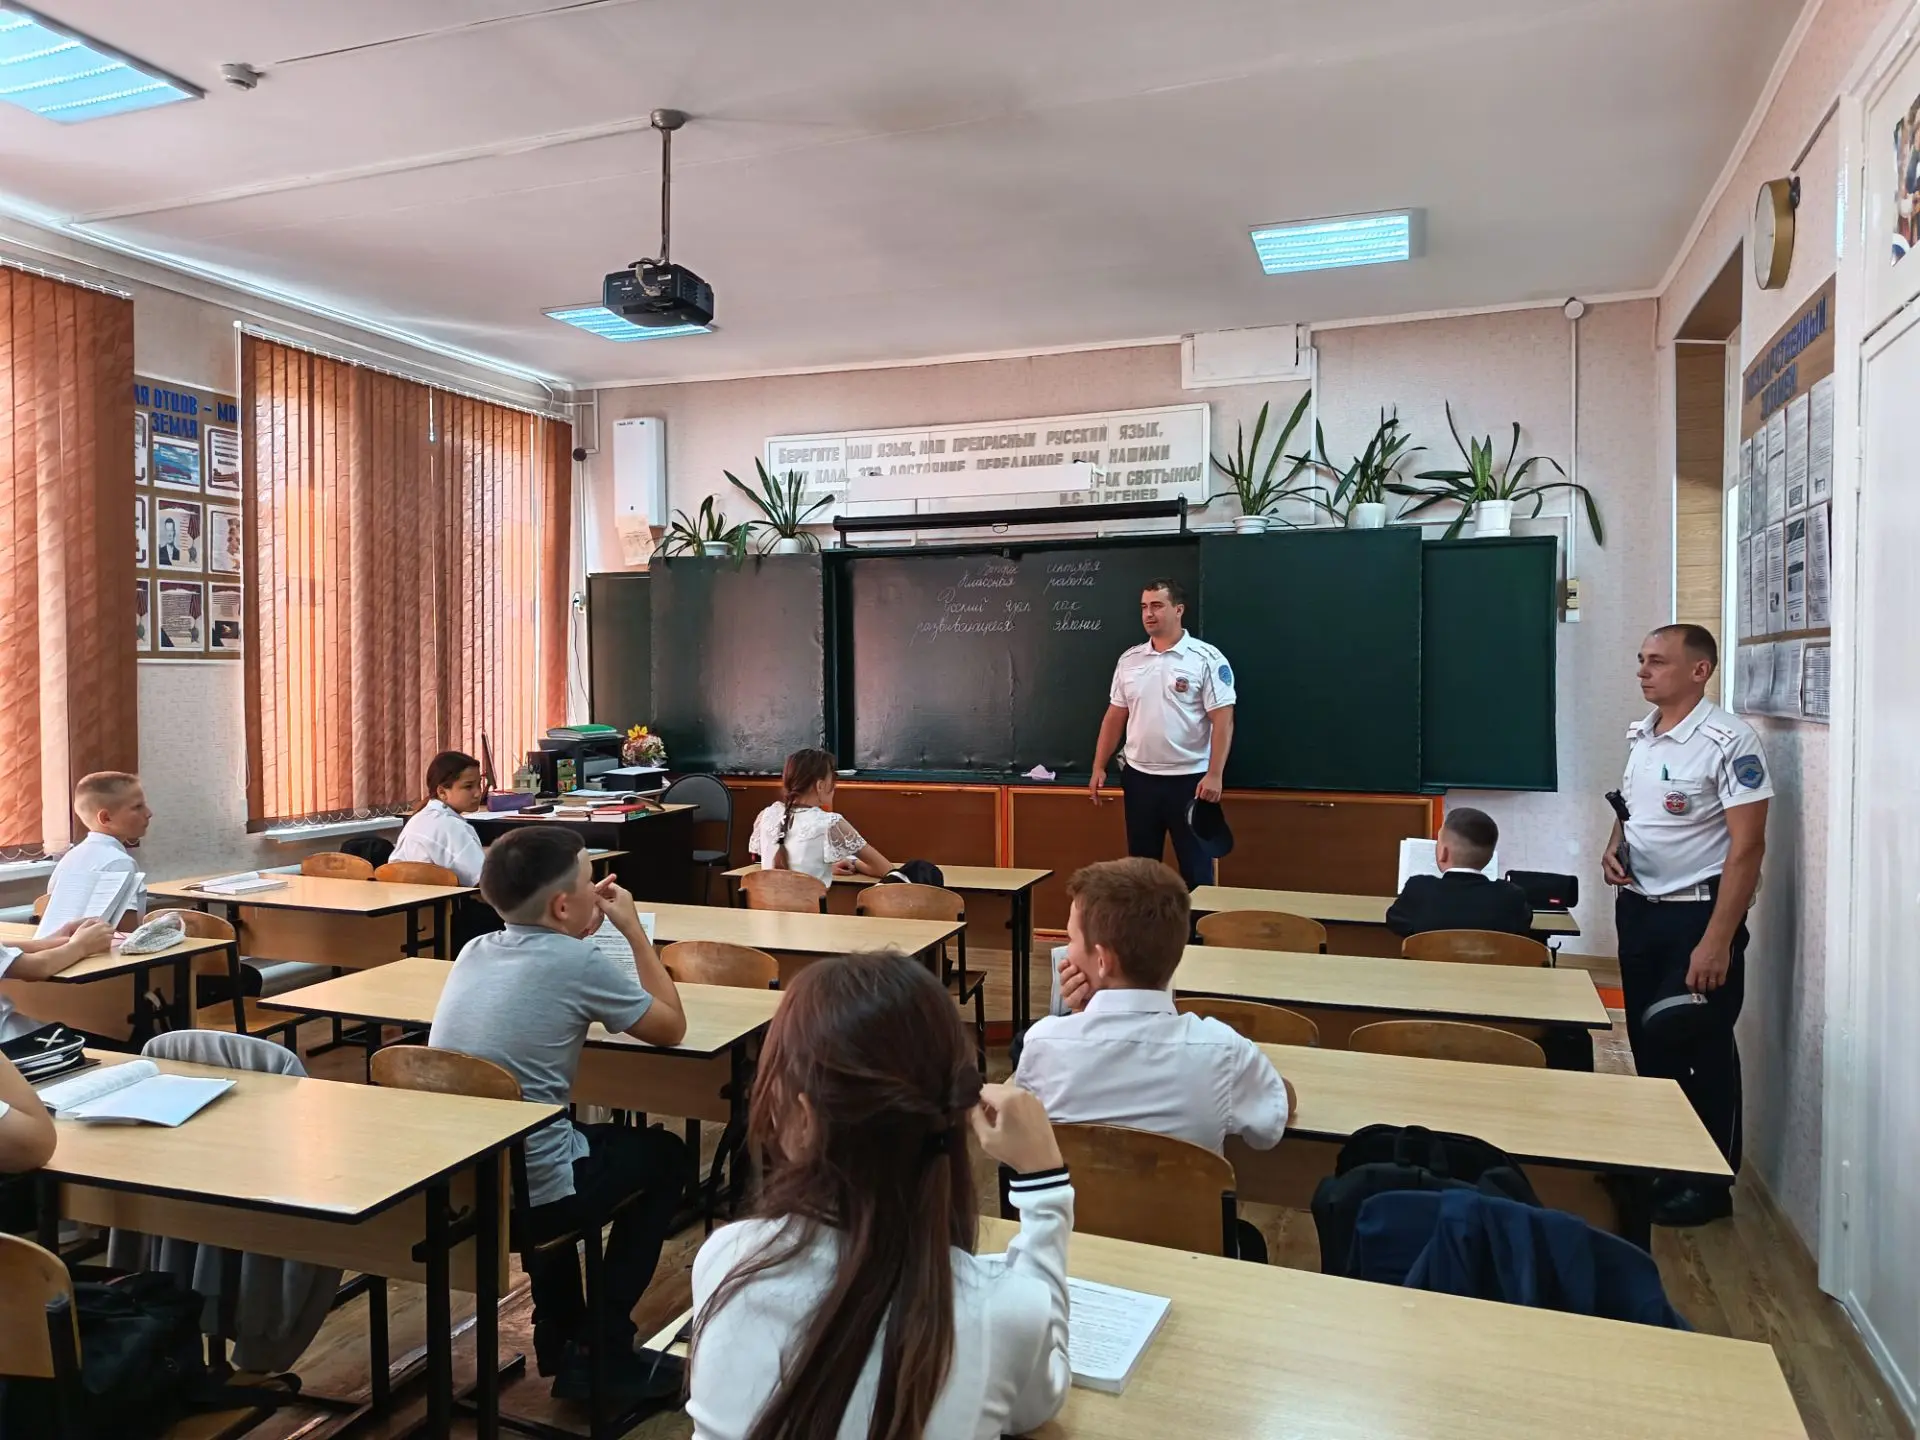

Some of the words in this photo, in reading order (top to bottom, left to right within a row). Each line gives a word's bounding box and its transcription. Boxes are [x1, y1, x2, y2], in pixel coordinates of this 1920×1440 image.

[153, 388, 198, 415] ОТЦОВ
[217, 401, 240, 424] МО
[151, 411, 198, 440] ЗЕМЛЯ
[778, 446, 840, 464] БЕРЕГИТЕ
[846, 444, 873, 460] НАШ
[877, 441, 916, 458] ЯЗЫК,
[919, 439, 946, 455] НАШ
[1046, 424, 1108, 446] РУССКИЙ
[1119, 421, 1164, 441] ЯЗЫК,
[1109, 445, 1170, 464] НАШИМИ
[1126, 462, 1203, 486] СВЯТЫНЮ!
[1088, 488, 1159, 504] ТРГЕНЕВ
